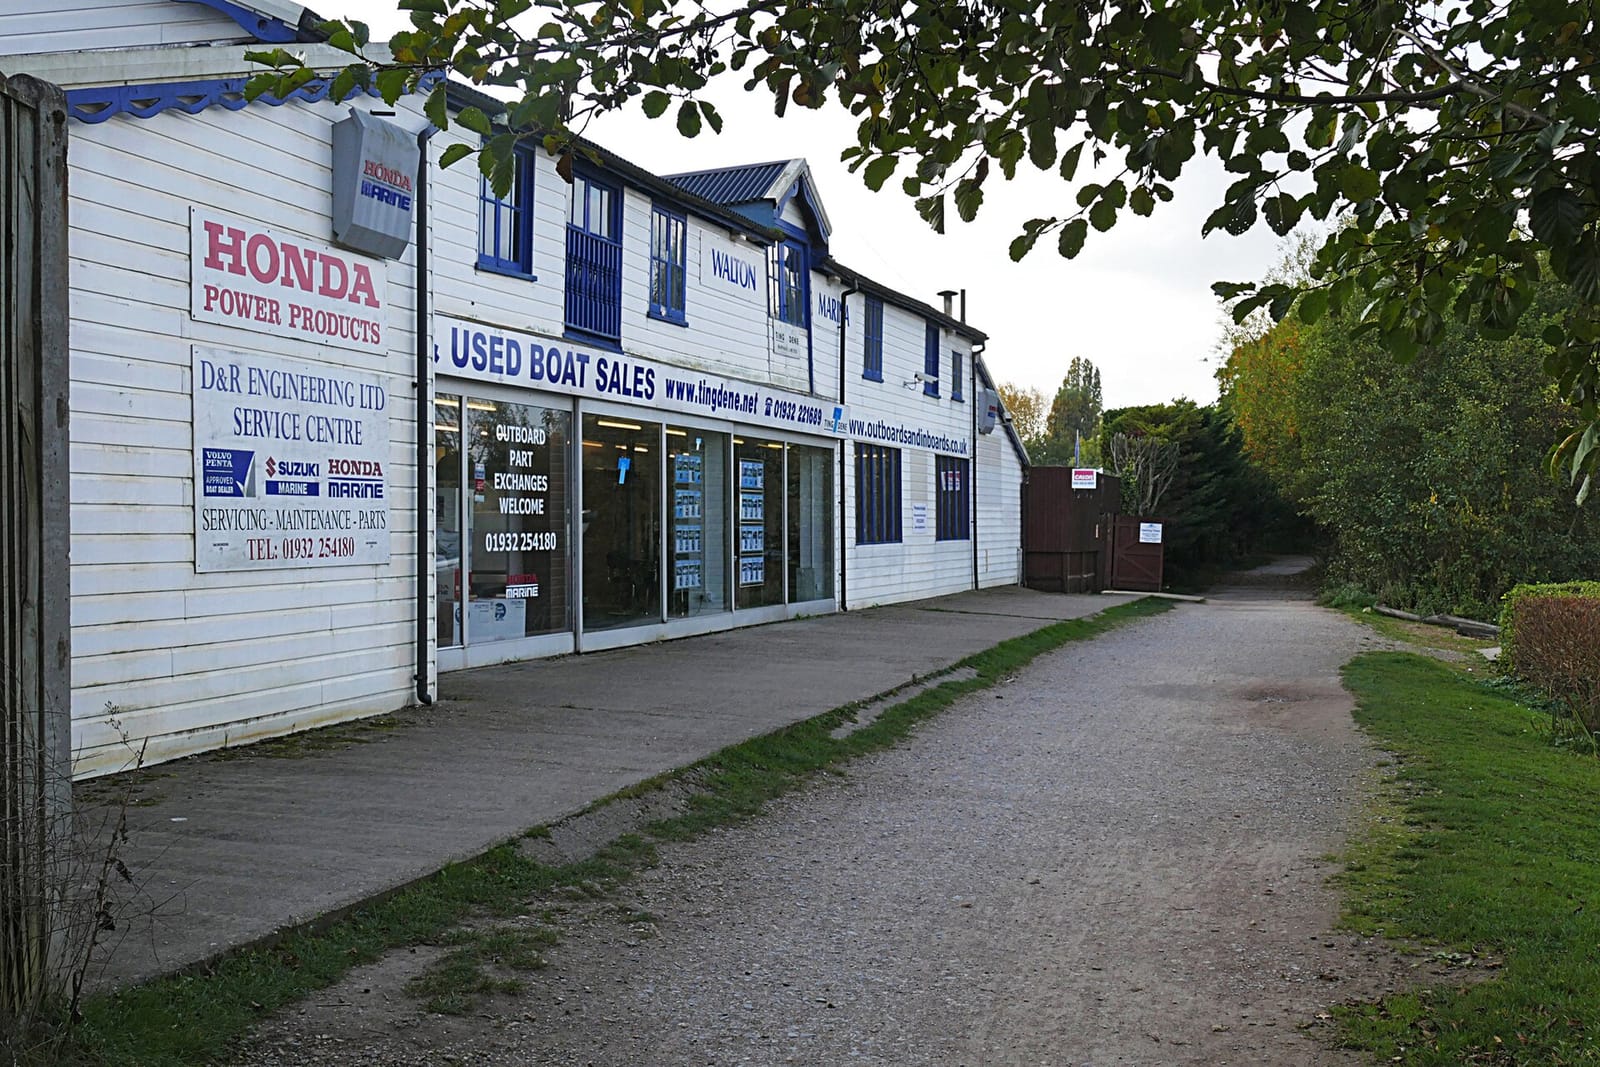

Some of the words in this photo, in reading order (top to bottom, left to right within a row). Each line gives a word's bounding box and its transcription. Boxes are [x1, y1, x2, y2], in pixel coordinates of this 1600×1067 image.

[363, 160, 412, 192] HONDA
[361, 180, 411, 211] MARINE
[204, 220, 380, 308] HONDA
[711, 248, 756, 291] WALTON
[203, 284, 282, 325] POWER
[288, 303, 380, 345] PRODUCTS
[451, 327, 522, 377] USED
[530, 343, 590, 388] BOAT
[595, 357, 656, 400] SALES
[200, 359, 242, 393] D&R
[247, 366, 354, 408] ENGINEERING
[359, 383, 385, 411] LTD
[665, 377, 758, 415] www.tingdene.net
[773, 399, 796, 421] 01932
[797, 404, 823, 426] 221689
[233, 406, 300, 440] SERVICE
[305, 414, 363, 446] CENTRE
[496, 424, 546, 446] OUTBOARD
[205, 459, 233, 468] PENTA
[206, 451, 232, 460] VOLVO
[509, 451, 534, 468] PART
[278, 461, 320, 477] SUZUKI
[328, 458, 384, 477] HONDA
[205, 476, 234, 485] APPROVED
[278, 482, 308, 494] MARINE
[328, 481, 384, 499] MARINE
[494, 472, 548, 492] EXCHANGES
[498, 497, 545, 515] WELCOME
[202, 508, 267, 531] SERVICING
[276, 509, 351, 530] MAINTENANCE
[358, 510, 386, 530] PARTS
[247, 538, 278, 561] TEL:
[282, 537, 313, 559] 01932
[318, 536, 355, 558] 254180
[485, 533, 519, 552] 01932
[520, 532, 557, 551] 254180
[505, 587, 539, 599] MARINE
